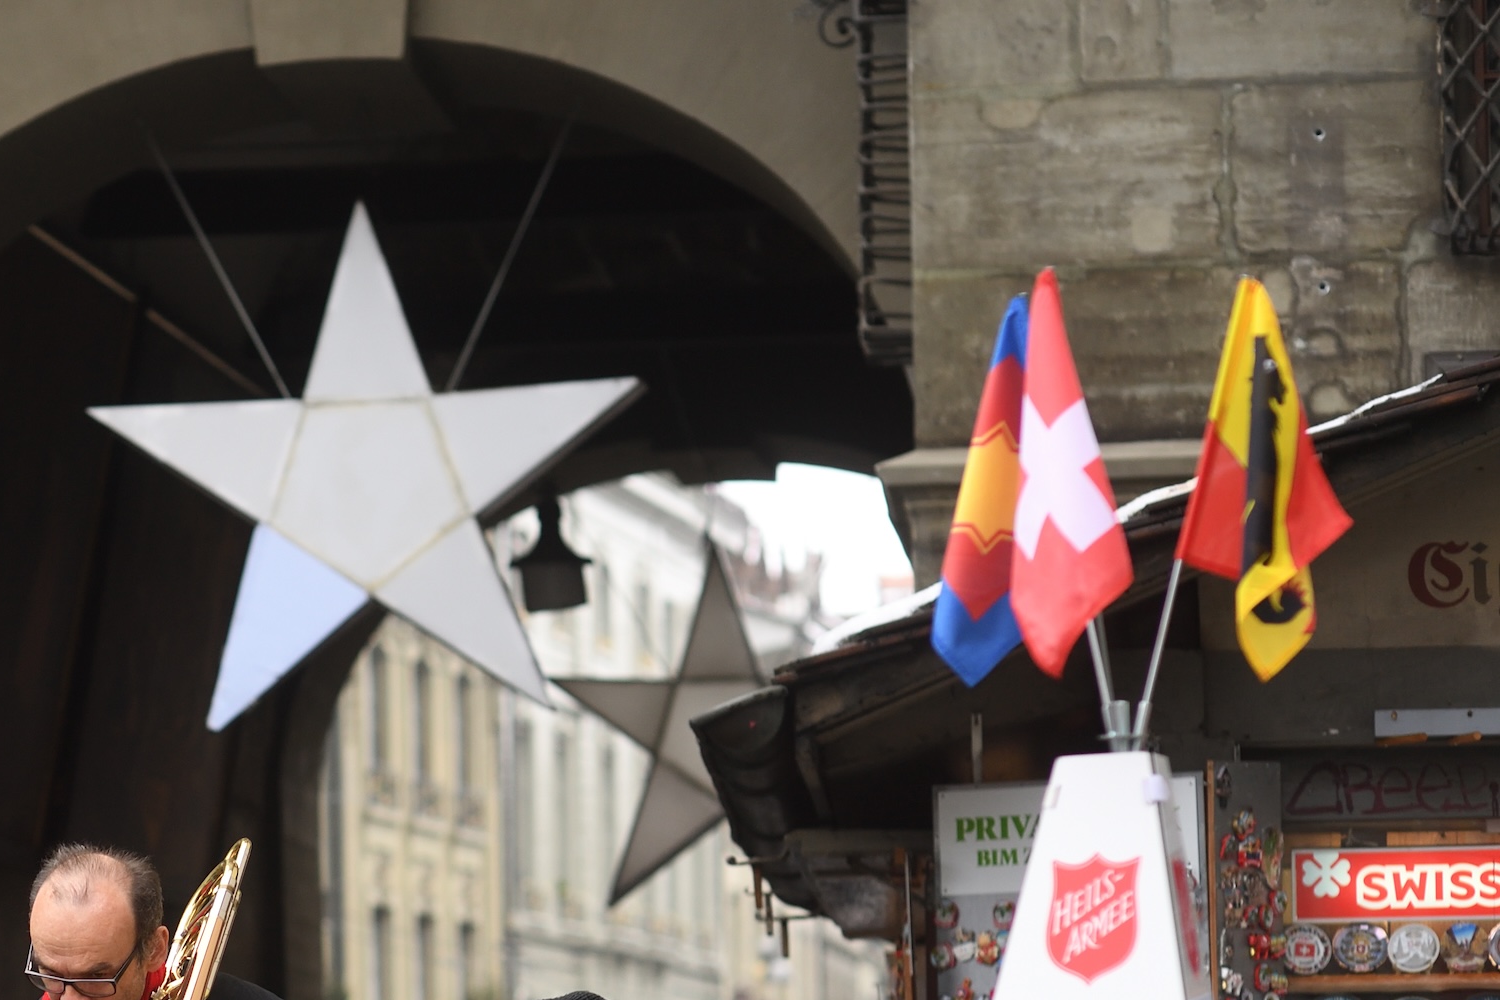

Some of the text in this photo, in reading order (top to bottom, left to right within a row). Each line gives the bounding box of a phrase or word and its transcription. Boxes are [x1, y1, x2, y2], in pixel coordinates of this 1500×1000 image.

[1407, 541, 1500, 608] Ci
[977, 848, 1018, 867] BIM
[1052, 869, 1125, 926] HEILS-
[1359, 866, 1500, 907] SWISS
[1062, 891, 1135, 964] ARMEE
